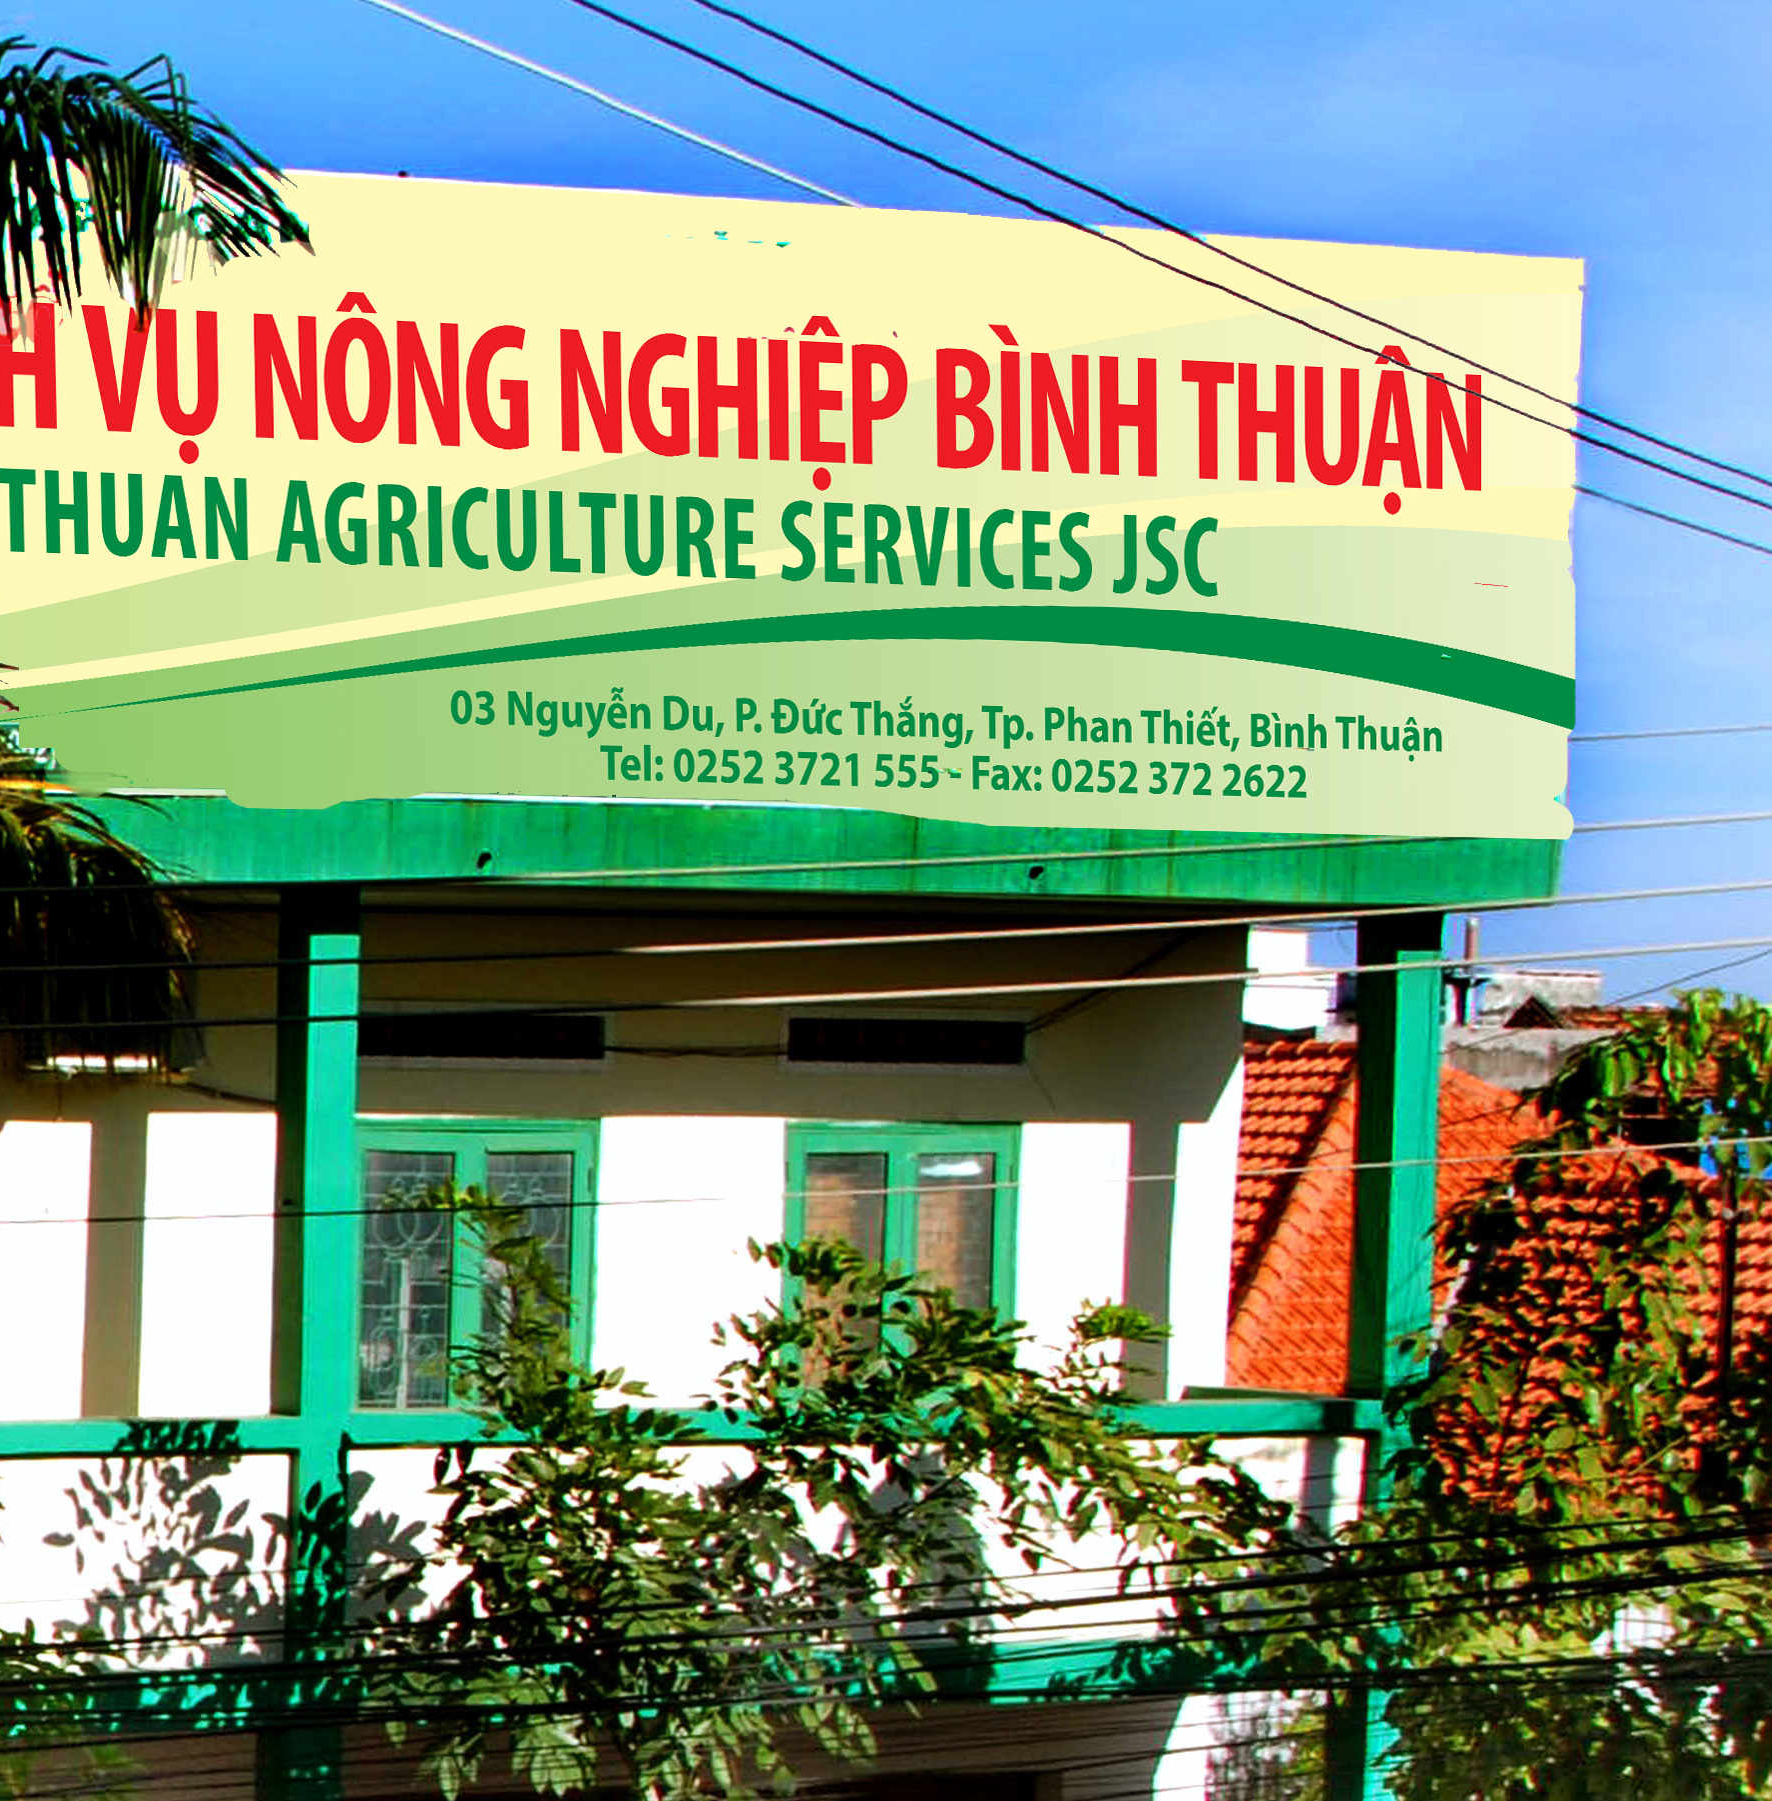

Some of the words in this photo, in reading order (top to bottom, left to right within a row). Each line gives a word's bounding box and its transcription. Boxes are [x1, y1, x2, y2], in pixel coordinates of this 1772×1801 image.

[81, 305, 218, 464] VỤ
[254, 292, 529, 449] NÔNG
[560, 316, 907, 491] NGHIỆP
[936, 325, 1157, 476] BÌNH
[1182, 345, 1481, 515] THUẬN
[276, 480, 756, 579] AGRICULTURE
[781, 501, 1092, 592] SERVICES
[1113, 515, 1218, 597] JSC
[451, 690, 495, 725] 03
[508, 687, 651, 739] Nguyễn
[664, 696, 724, 737] Du,
[736, 698, 762, 733] P.
[771, 699, 842, 735] Đức
[850, 696, 973, 748] Thắng,
[982, 706, 1033, 749] Tp.
[1045, 707, 1132, 743] Phan
[1141, 707, 1240, 752] Thiết,
[1248, 713, 1326, 749] Bình
[1336, 715, 1442, 762] Thuận
[600, 745, 663, 781] Tel:
[674, 748, 763, 784] 0252
[775, 751, 858, 786] 3721
[973, 756, 1042, 791] Fax:
[1052, 759, 1137, 793] 0252
[1149, 762, 1211, 795] 372
[1223, 764, 1306, 798] 2622
